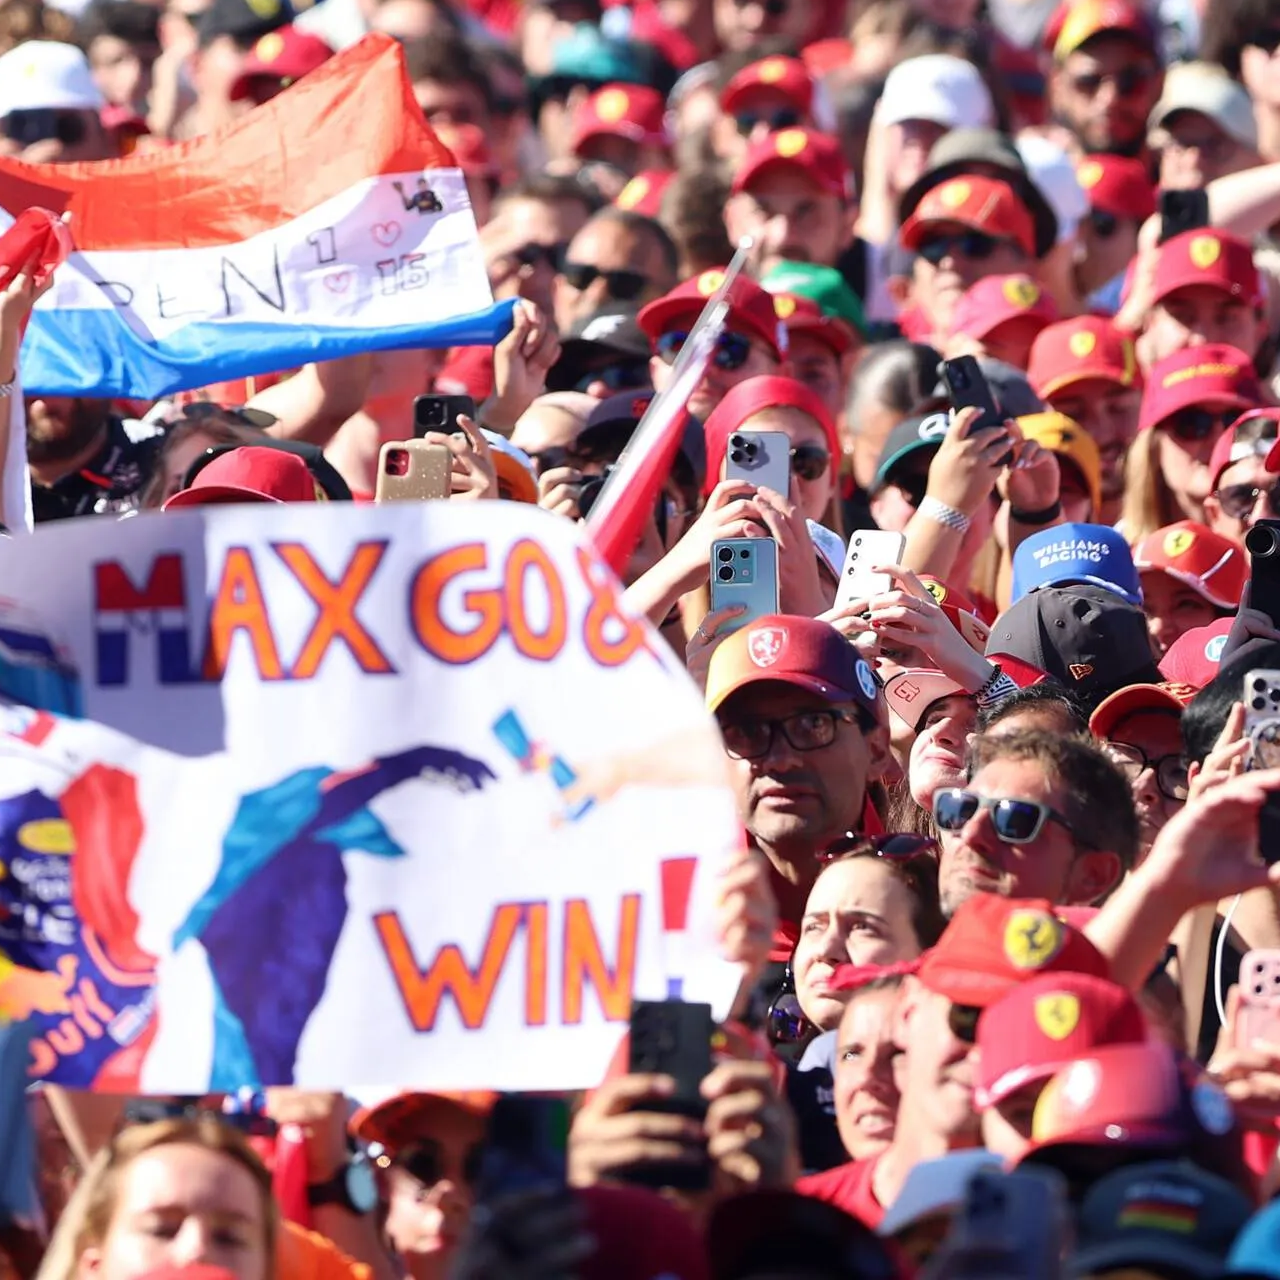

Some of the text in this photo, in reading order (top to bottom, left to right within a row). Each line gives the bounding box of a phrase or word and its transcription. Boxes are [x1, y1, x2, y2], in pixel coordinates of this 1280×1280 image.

[1032, 539, 1110, 561] WILLIAMS
[1039, 550, 1102, 569] RACING
[93, 539, 399, 687] MAX
[408, 536, 567, 665] GO
